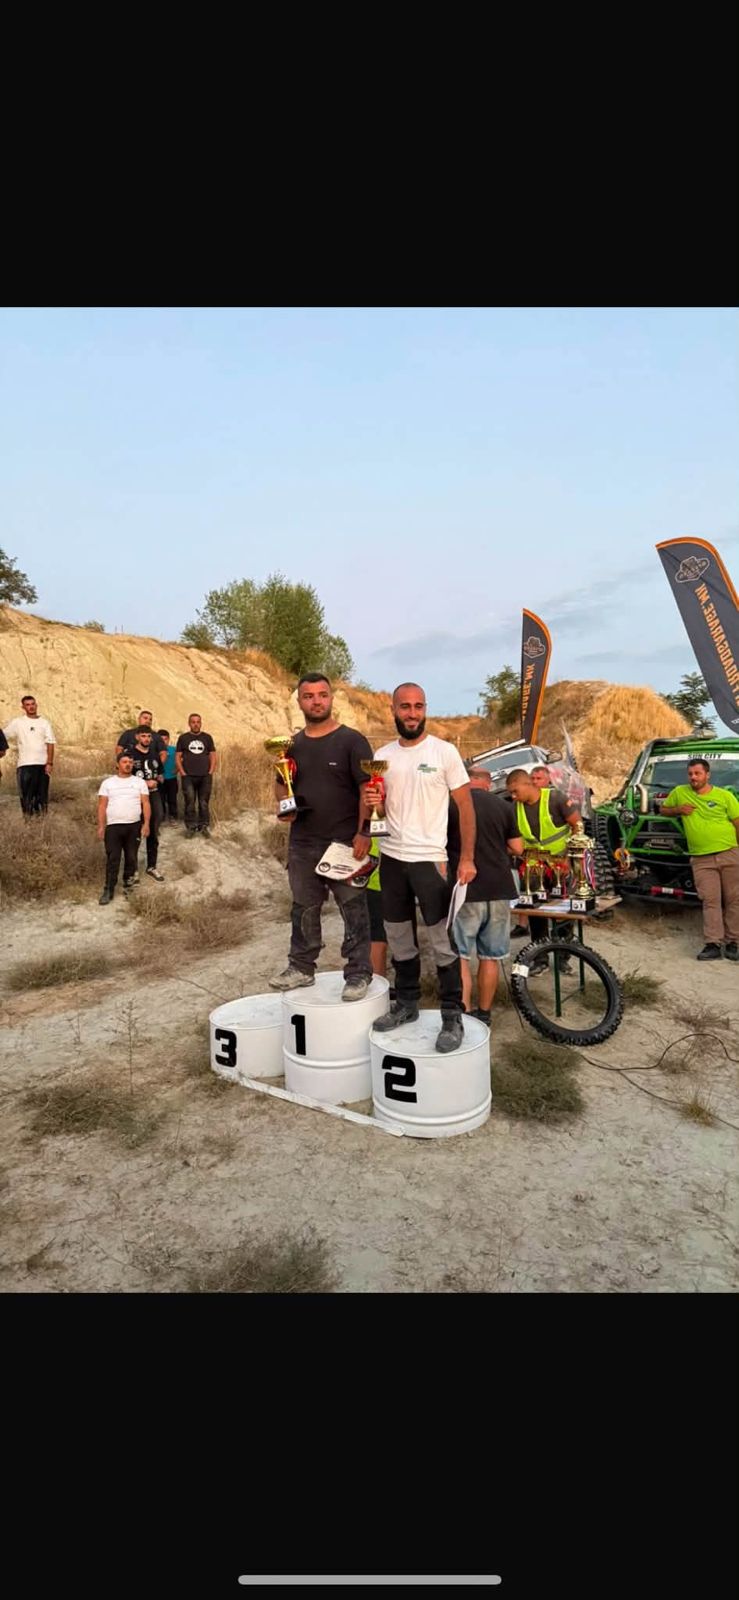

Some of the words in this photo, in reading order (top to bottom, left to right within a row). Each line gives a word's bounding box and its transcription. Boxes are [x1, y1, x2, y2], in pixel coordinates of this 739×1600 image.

[215, 1028, 237, 1068] 3
[291, 1014, 307, 1056] 1
[382, 1055, 417, 1103] 2
